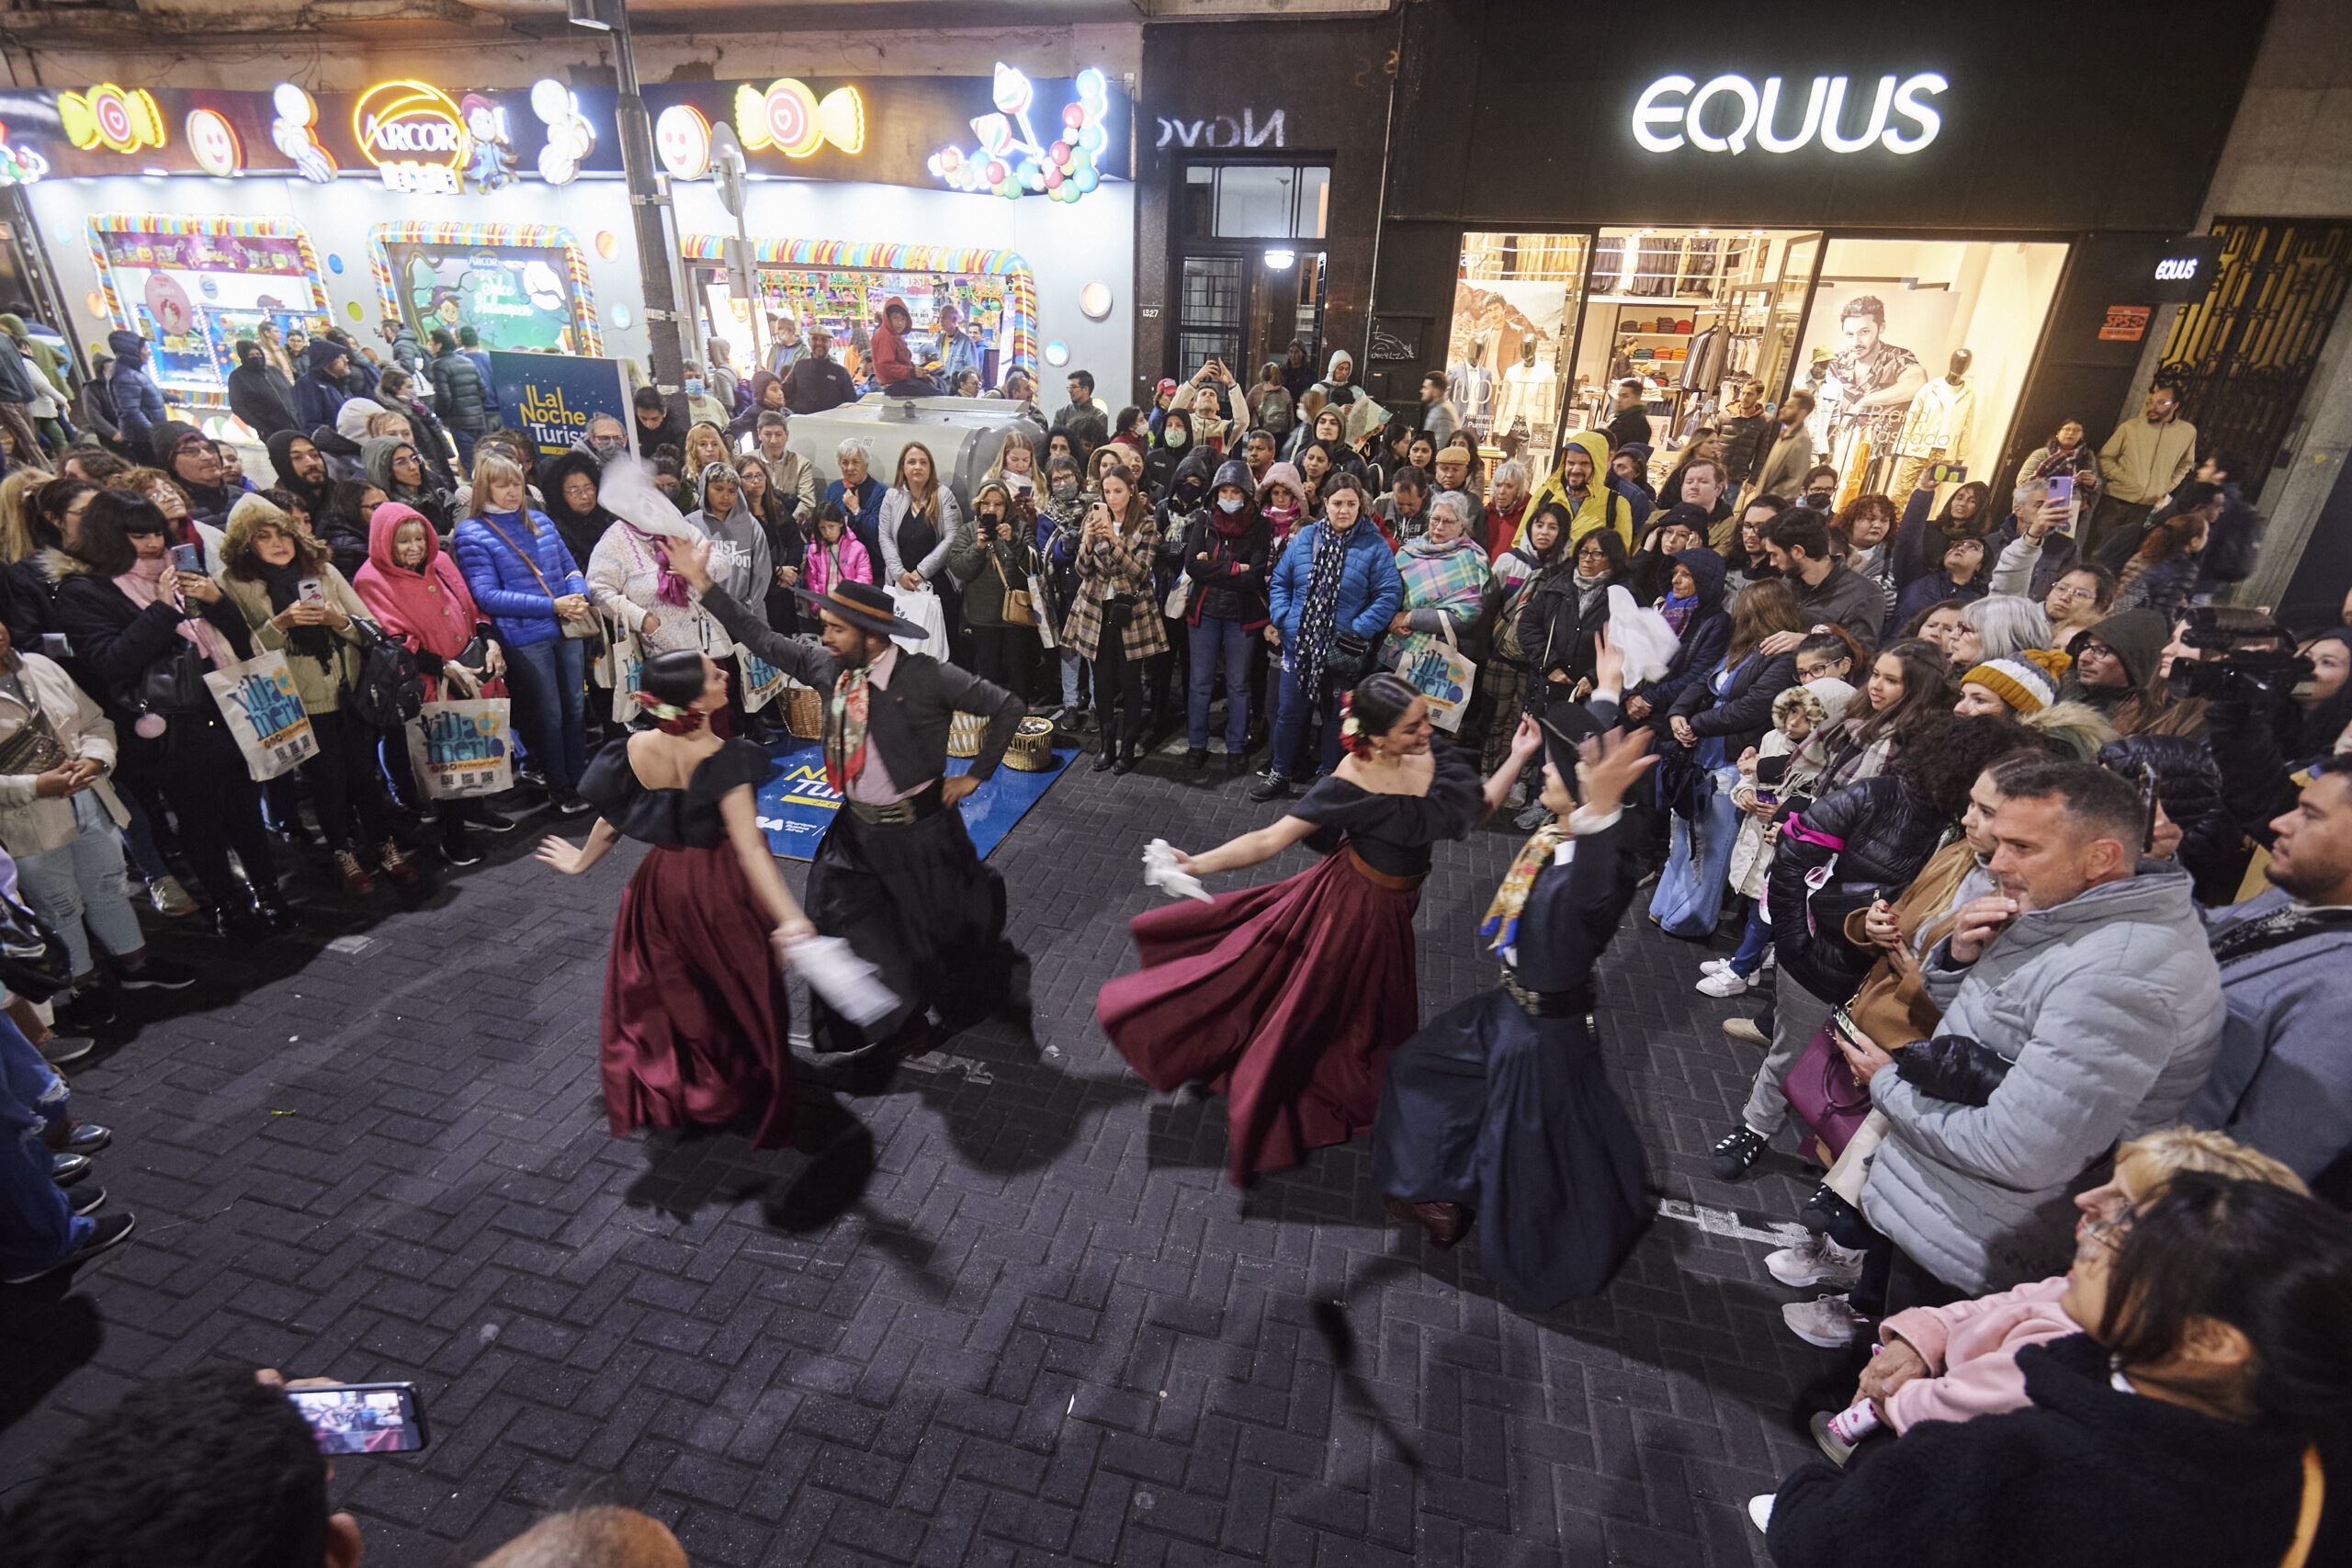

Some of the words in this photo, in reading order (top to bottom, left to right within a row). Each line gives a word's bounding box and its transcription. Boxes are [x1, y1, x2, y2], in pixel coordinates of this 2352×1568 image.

[364, 112, 460, 152] ARCOR
[1632, 73, 1949, 156] EQUUS
[469, 255, 499, 267] ARCOR
[2154, 258, 2199, 280] EQUUS
[519, 384, 586, 427] Noche
